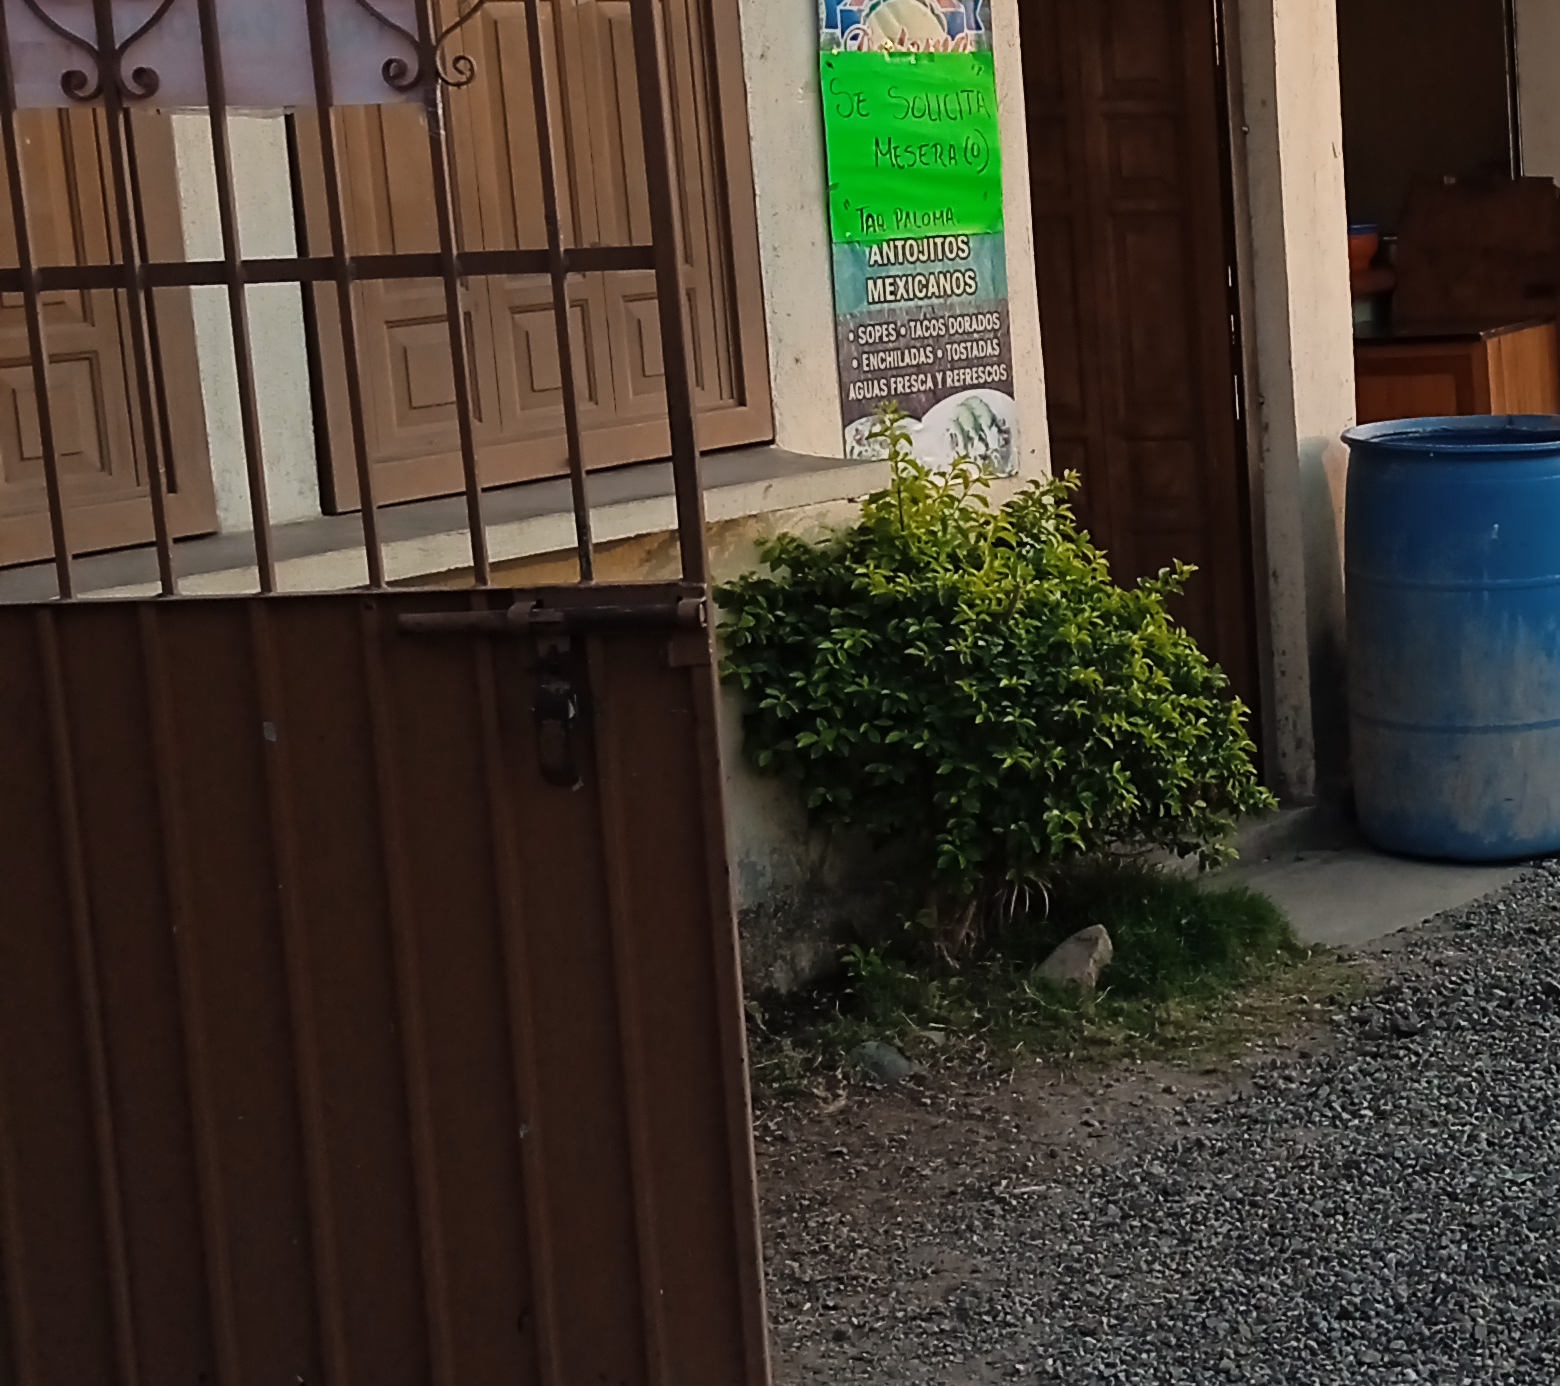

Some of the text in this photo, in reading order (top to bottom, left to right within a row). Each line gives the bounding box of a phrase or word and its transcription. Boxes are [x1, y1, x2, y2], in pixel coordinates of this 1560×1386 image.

[829, 77, 991, 122] SE SOLICITA
[893, 206, 957, 230] PALOMA
[868, 235, 971, 267] ANTOJITOS
[866, 270, 978, 305] MEXICANOS
[857, 313, 1001, 345] SOPES TACOS DORADOS
[862, 338, 1001, 372] ENCHILADAS TOSTADAS
[848, 363, 1008, 401] AGUAS FRESCA Y REFRESCOS
